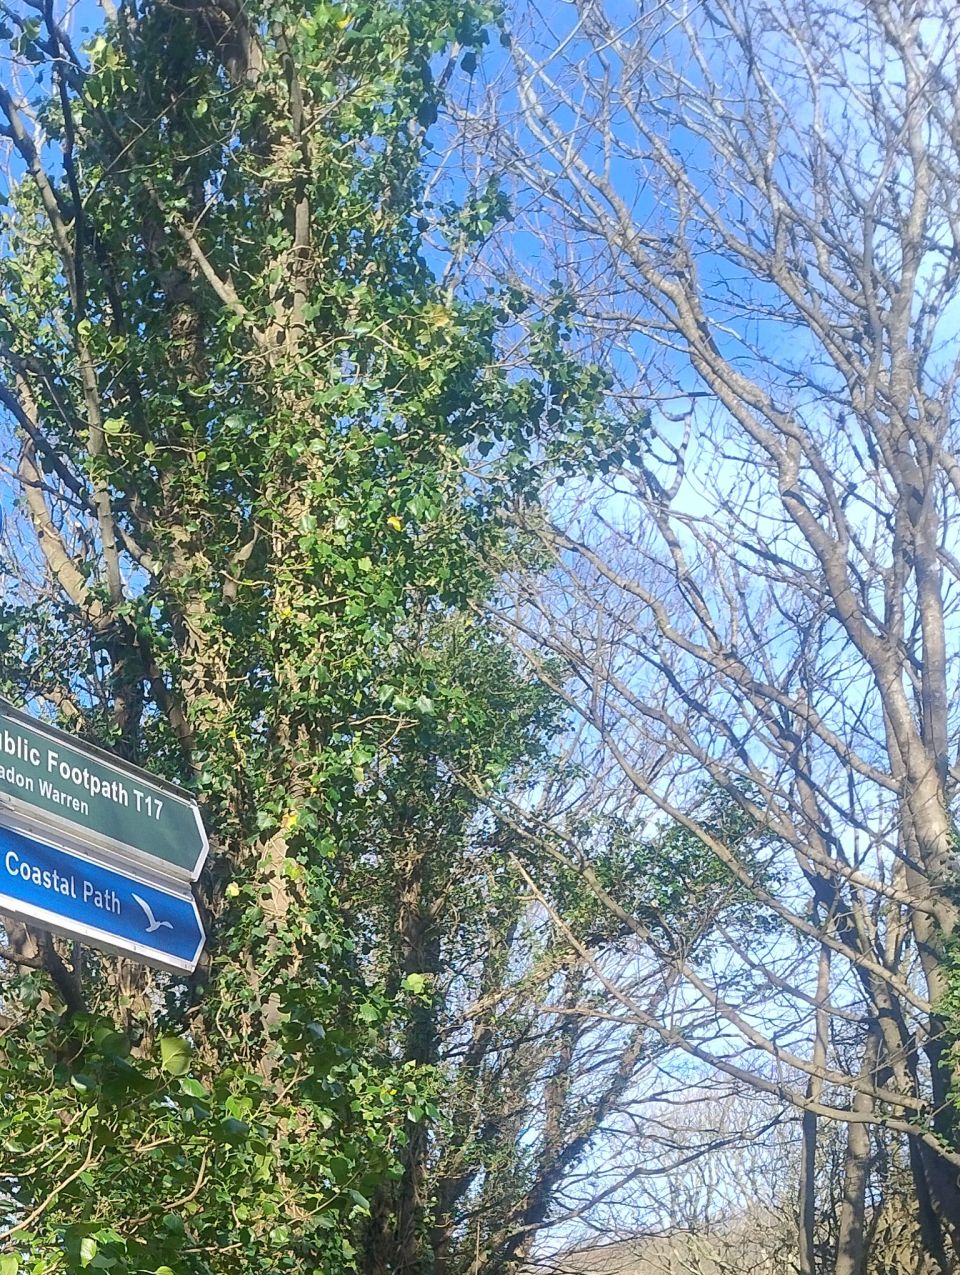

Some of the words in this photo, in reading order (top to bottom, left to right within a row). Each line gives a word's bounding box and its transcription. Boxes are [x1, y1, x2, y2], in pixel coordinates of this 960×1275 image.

[39, 778, 89, 816] Warren
[47, 751, 129, 807] Footpath
[134, 789, 164, 820] T17
[5, 851, 77, 899] Coastal
[83, 881, 121, 915] Path
